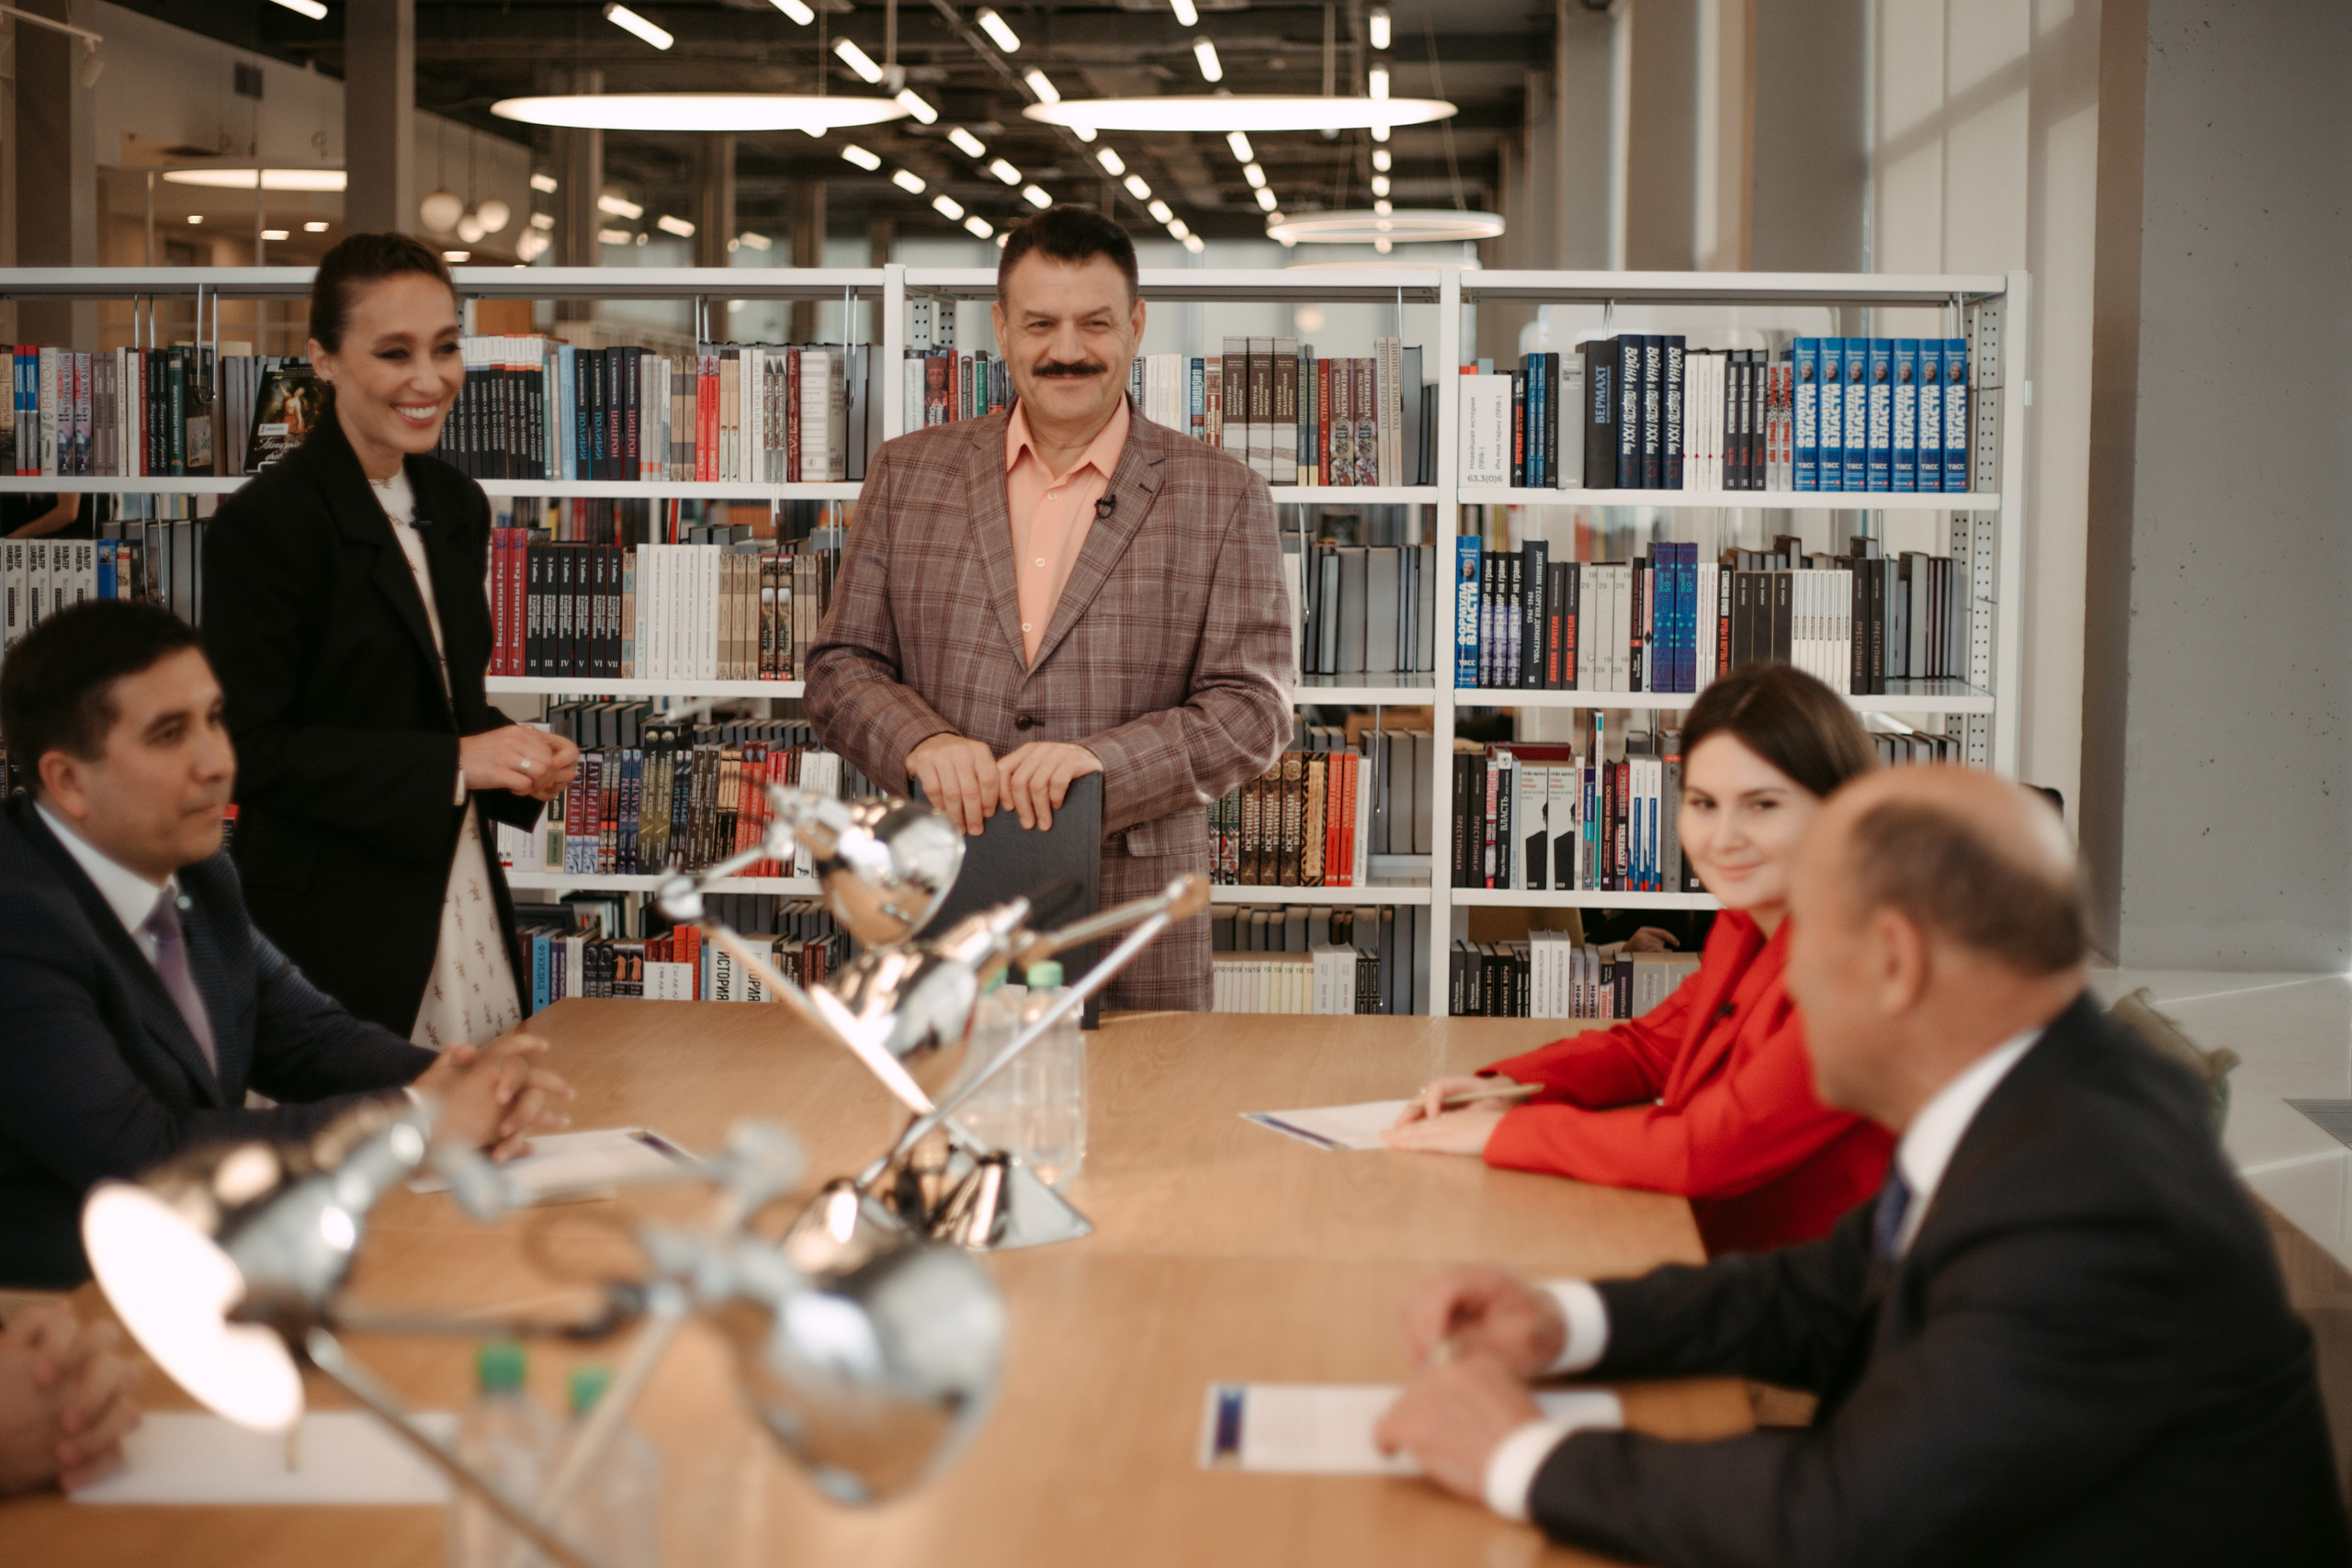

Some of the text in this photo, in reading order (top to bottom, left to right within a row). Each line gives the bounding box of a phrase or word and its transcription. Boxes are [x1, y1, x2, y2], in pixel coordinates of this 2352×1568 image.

[41, 362, 53, 410] РОДНЯ
[1623, 346, 1639, 382] ВОЙНА
[1645, 346, 1661, 382] ВОЙНА
[1379, 343, 1388, 431] ТЕОДОРИХ ВЕЛИКИЙ
[1391, 343, 1400, 431] ТЕОДОРИХ ВЕЛИКИЙ
[1595, 366, 1606, 423] ВЕРМАХТ
[1622, 389, 1635, 423] ОБЩЕСТВО
[1644, 389, 1657, 423] ОБЩЕСТВО
[579, 412, 587, 460] ПОЛИБИЙ
[594, 412, 603, 460] ПОЛИБИЙ
[610, 410, 618, 457] ЦИЦЕРОН
[1894, 384, 1904, 448] ФОРМУЛА
[1904, 384, 1915, 448] ВЛАСТИ
[1919, 384, 1929, 448] ФОРМУЛА
[1929, 384, 1939, 448] ВЛАСТИ
[1946, 384, 1955, 448] ФОРМУЛА
[1955, 384, 1966, 448] ВЛАСТИ
[1467, 474, 1504, 484] 63.3(0)6
[1920, 462, 1939, 470] тасс
[1947, 462, 1964, 470] тасс
[52, 545, 61, 572] ШАЙДЕЛЬ
[1535, 550, 1544, 585] ДНЕВНИК
[1511, 593, 1520, 612] МИР
[1513, 582, 1520, 592] на
[513, 582, 521, 648] Воссозданный
[1457, 581, 1467, 646] ФОРМУЛА
[1467, 581, 1478, 646] ВЛАСТИ
[545, 660, 553, 668] III
[560, 660, 569, 668] IV
[594, 660, 603, 668] VI
[607, 660, 617, 669] VII
[1549, 651, 1557, 682] ДНЕВНИК
[1566, 651, 1574, 682] ДНЕВНИК
[603, 762, 611, 788] РИМА
[612, 762, 620, 788] РИМА
[649, 750, 657, 794] ЭЛЛИНИЗМА
[664, 750, 673, 794] ЭЛЛИНИЗМА
[1487, 770, 1497, 816] ЛИМОНОВ
[586, 762, 599, 834] МИТРИДАТ
[620, 777, 629, 823] КЕЛЬТЫ
[630, 777, 639, 823] КЕЛЬТЫ
[1500, 795, 1509, 831] ВЛАСТЬ
[1618, 775, 1626, 817] ШПИОНЫ
[1245, 793, 1253, 852] ЮСТИНИАН
[1617, 823, 1626, 866] АТОМНЫЕ
[537, 944, 545, 990] ФУКИДИД
[716, 951, 730, 1001] ИСТОРИЯ
